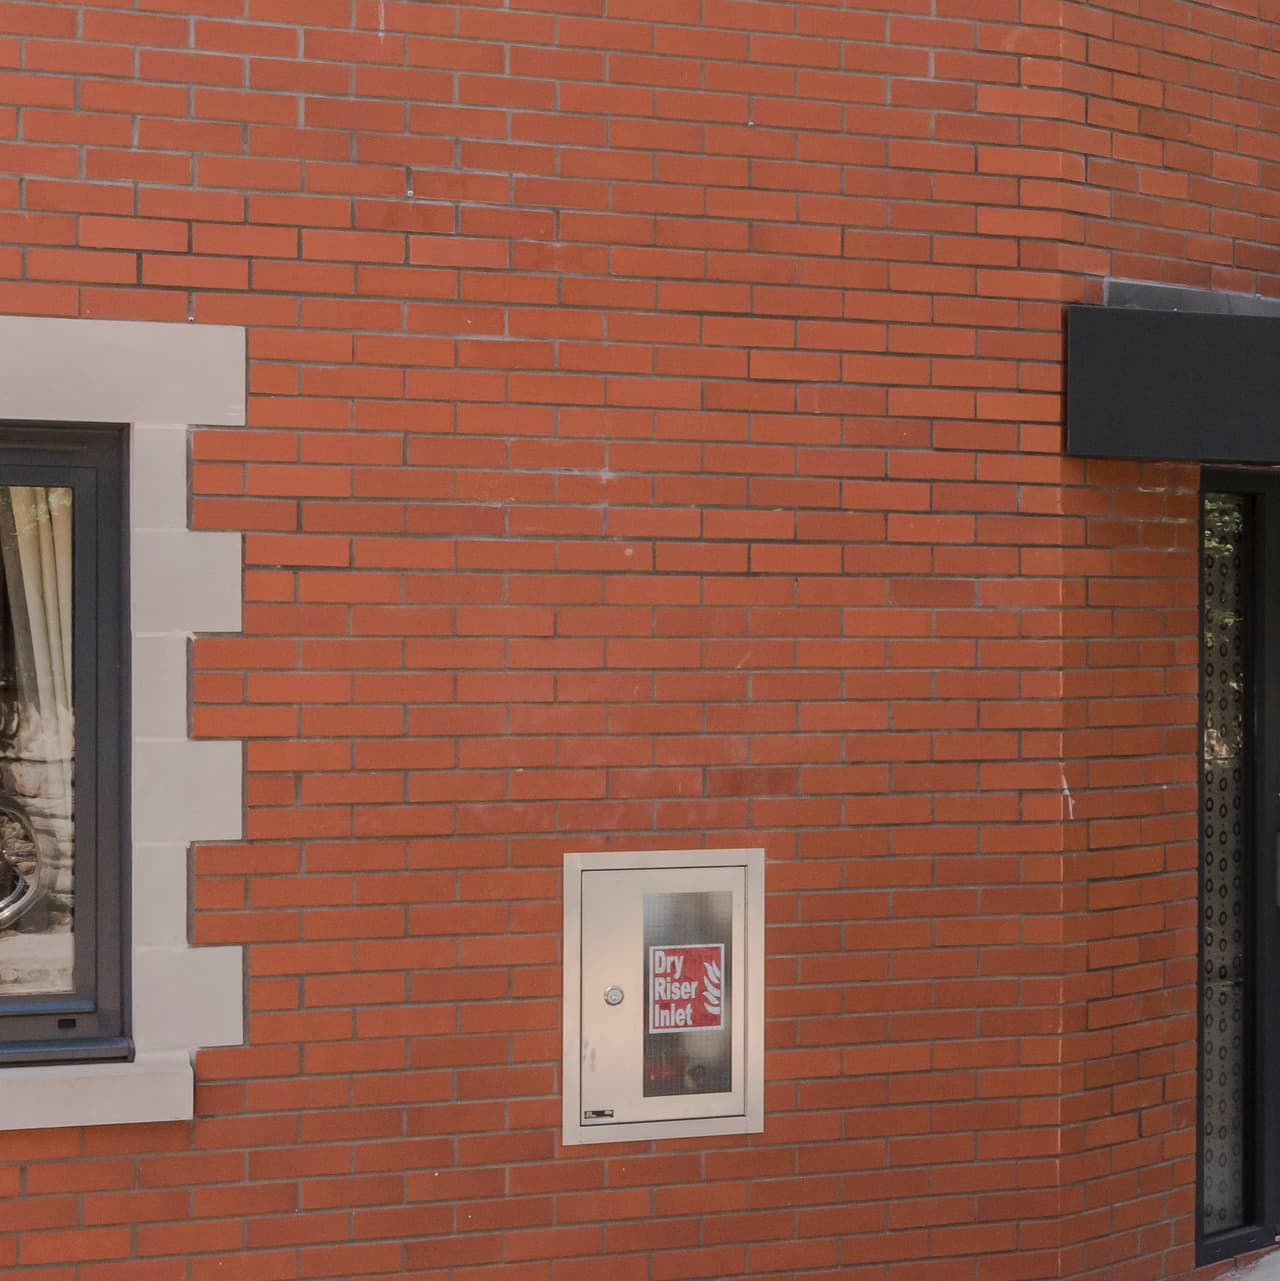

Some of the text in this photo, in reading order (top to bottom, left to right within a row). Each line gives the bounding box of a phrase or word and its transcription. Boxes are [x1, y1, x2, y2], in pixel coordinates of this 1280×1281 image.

[654, 950, 684, 980] Dry
[654, 977, 698, 1001] Riser
[654, 1003, 693, 1028] Inlet
